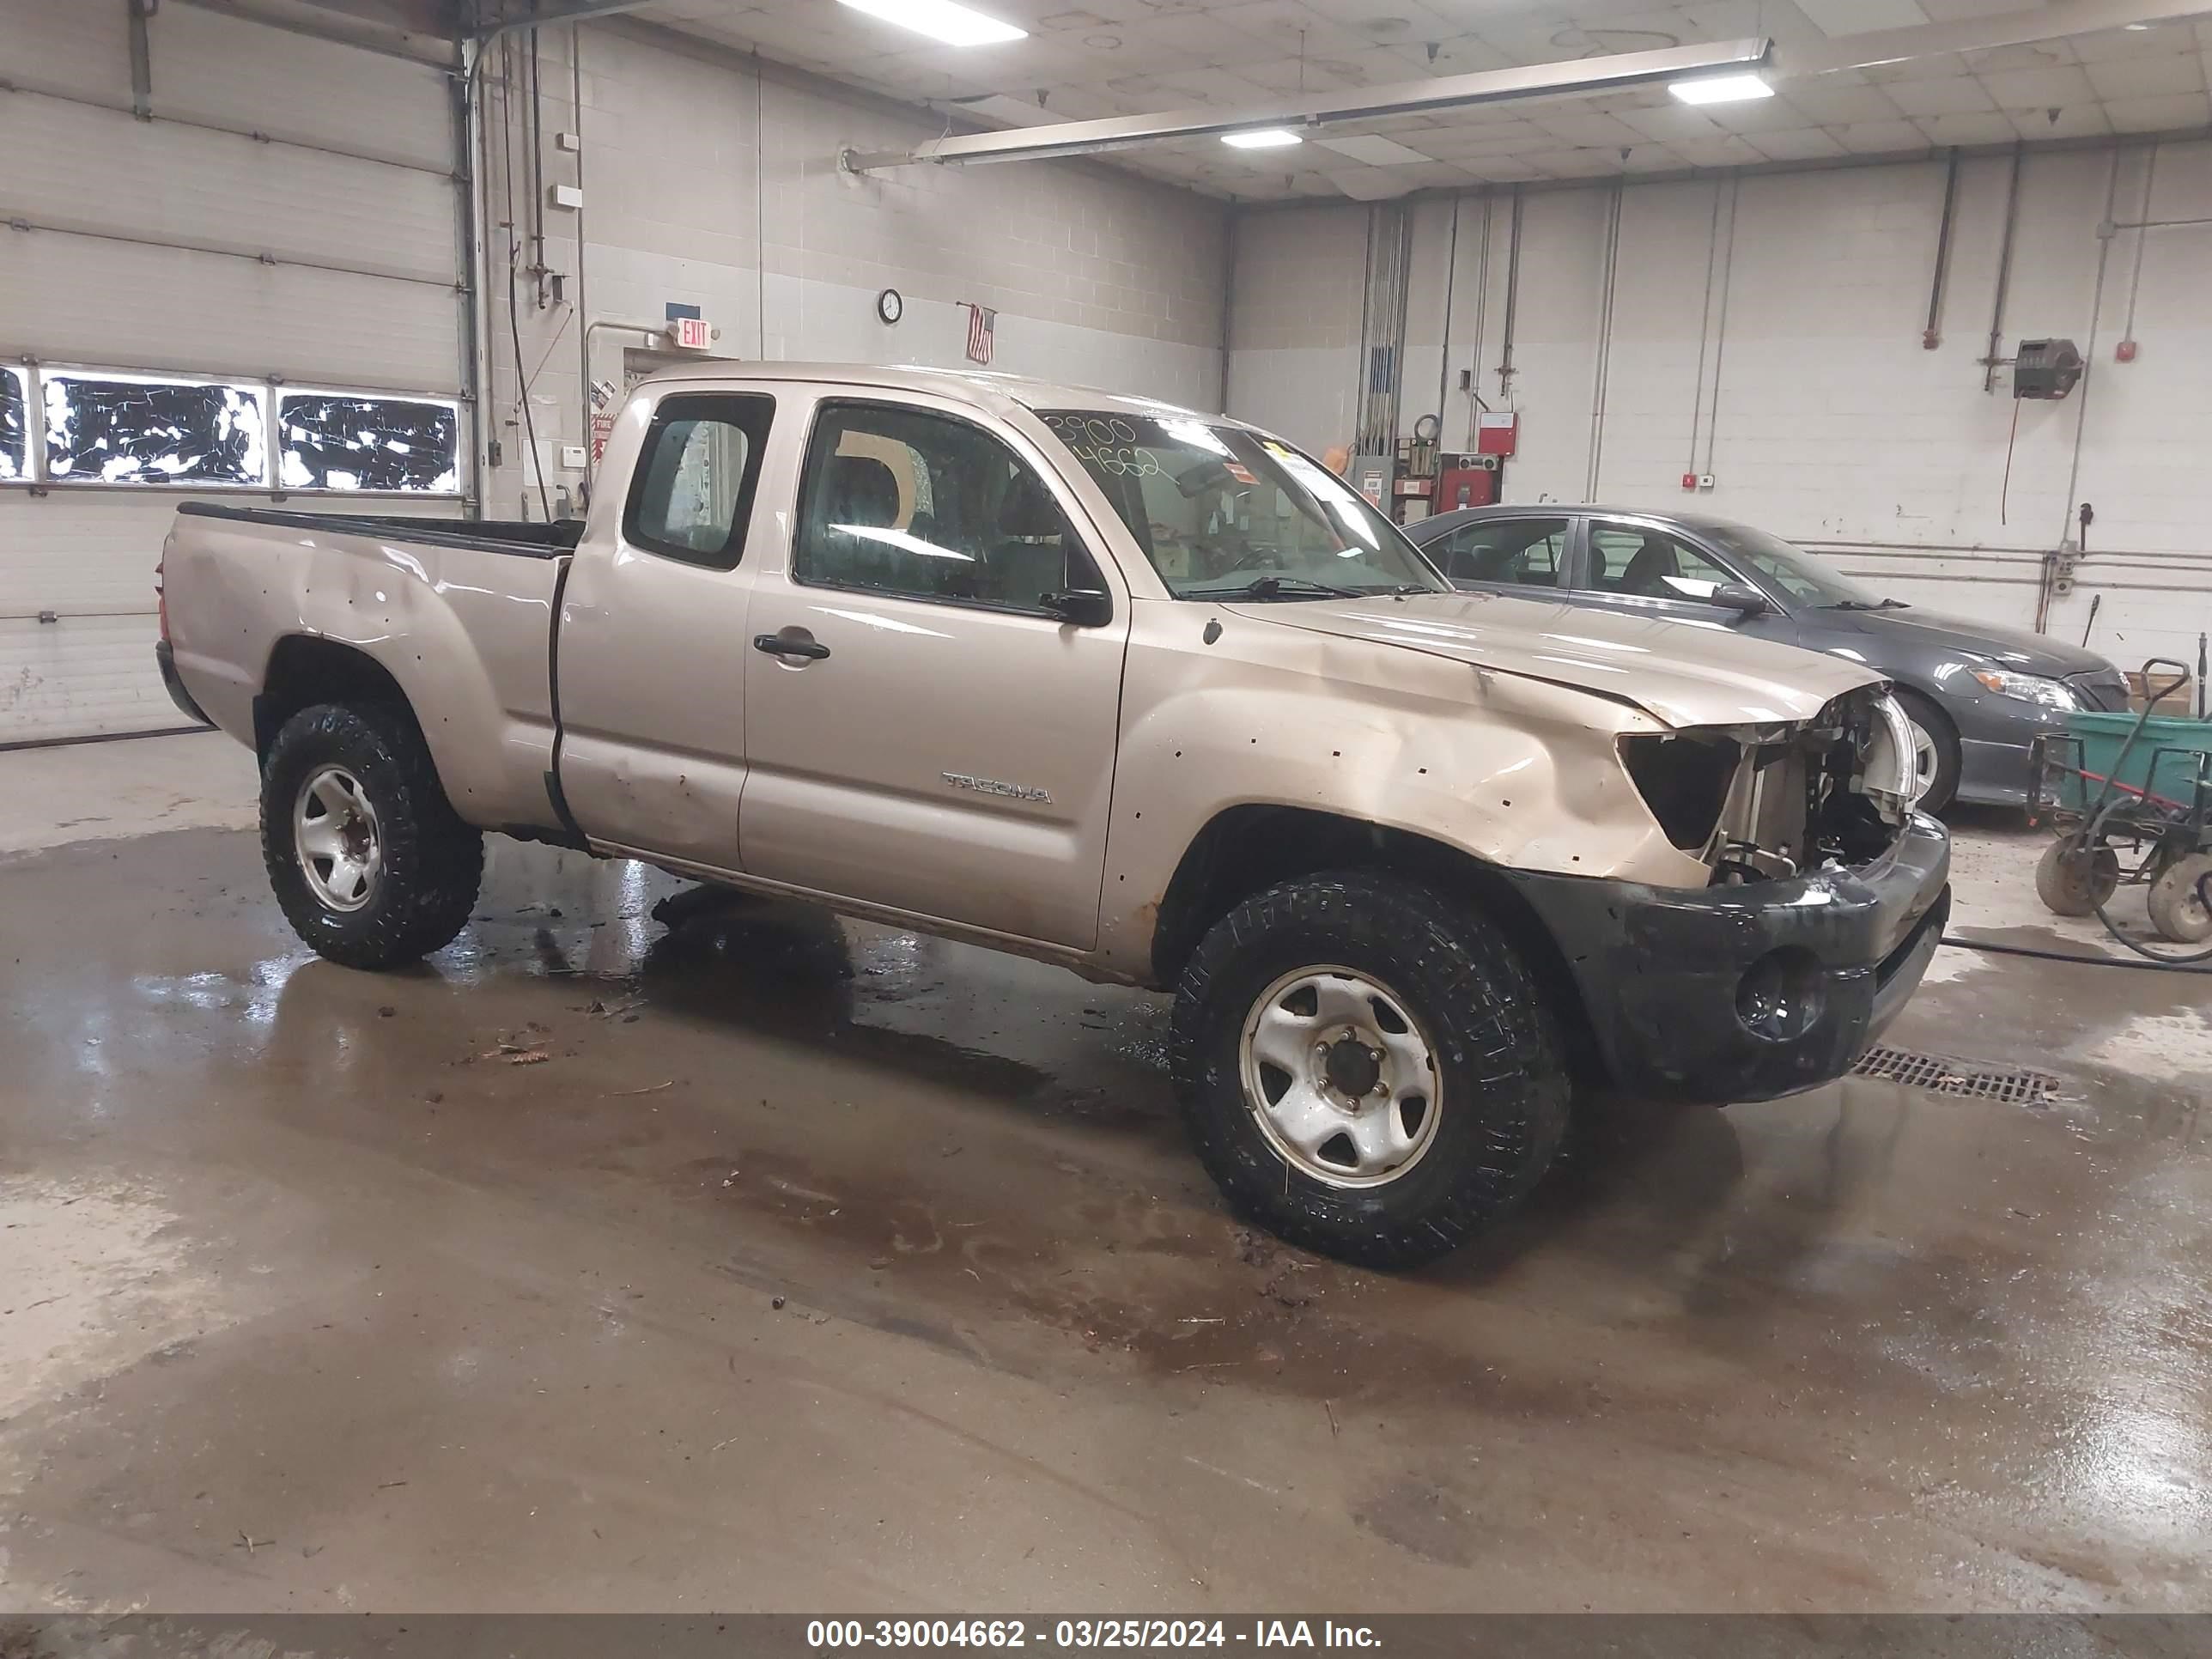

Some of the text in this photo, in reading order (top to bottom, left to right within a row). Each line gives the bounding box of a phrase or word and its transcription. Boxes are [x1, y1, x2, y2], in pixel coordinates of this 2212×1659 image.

[684, 320, 707, 346] EXIT
[1044, 416, 1136, 446] 3900
[1073, 445, 1181, 485] 4662
[941, 771, 1053, 804] TACOMA
